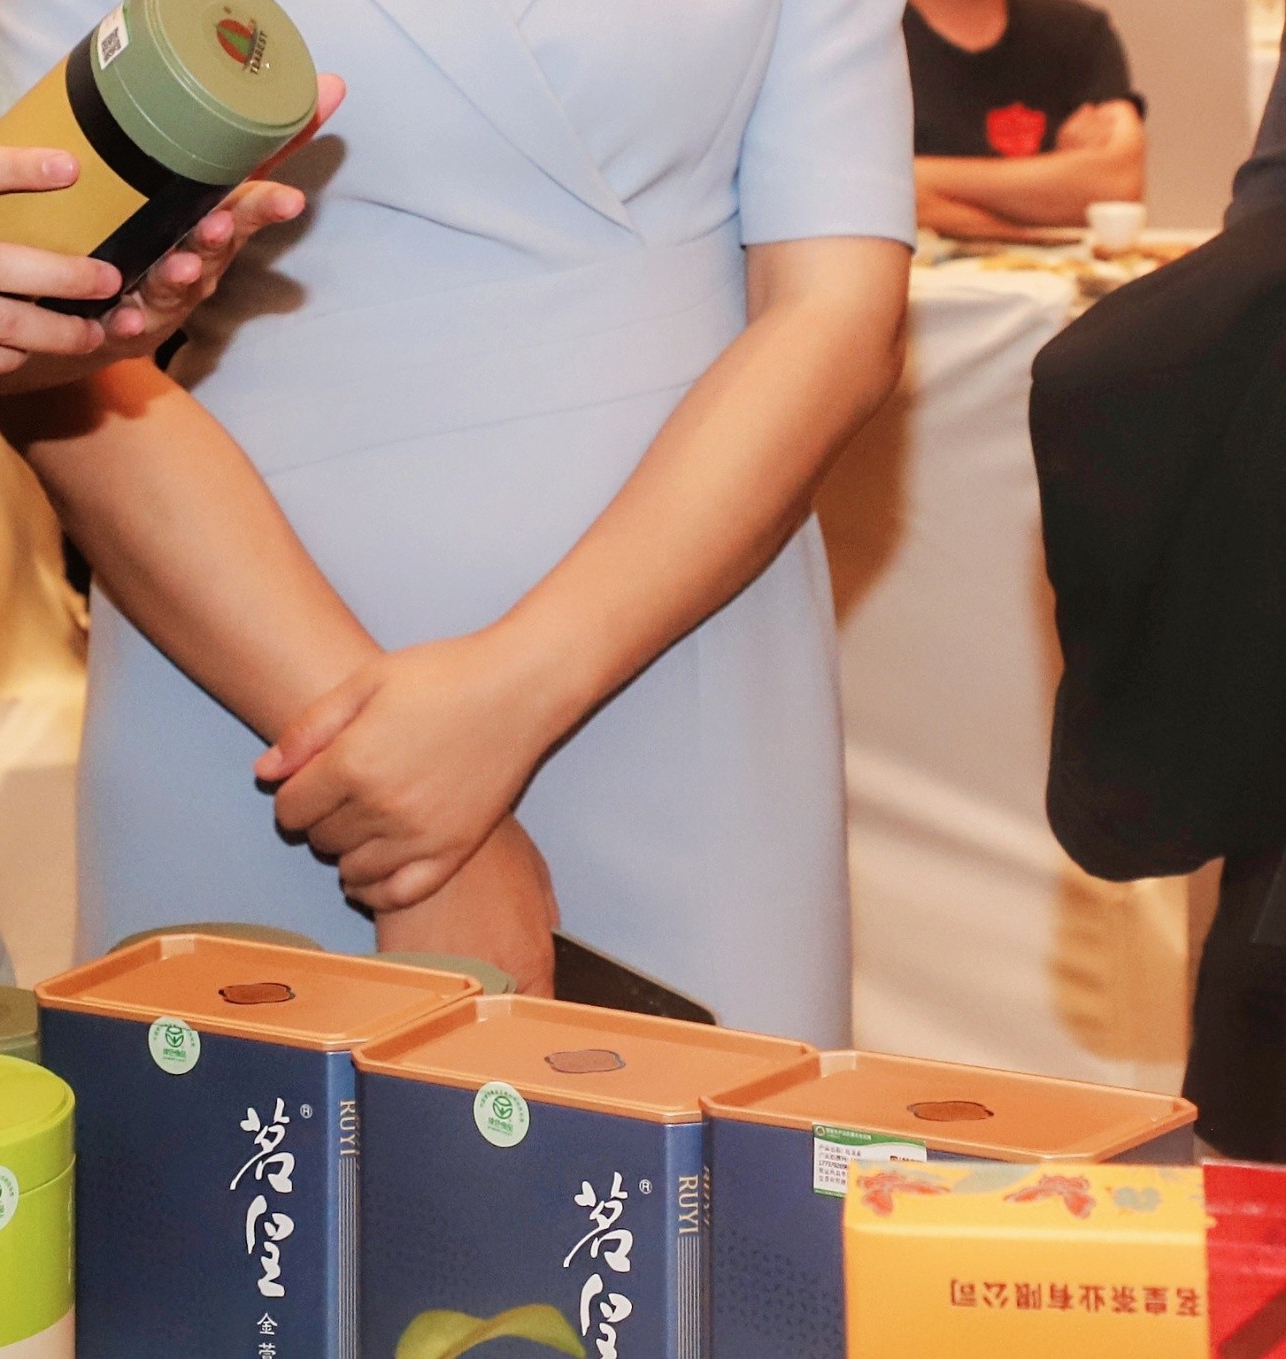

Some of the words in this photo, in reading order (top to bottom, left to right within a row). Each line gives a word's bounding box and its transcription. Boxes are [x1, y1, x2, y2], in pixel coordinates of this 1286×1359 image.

[339, 1100, 358, 1156] RUYI
[677, 1174, 699, 1235] RUYI
[949, 1278, 1202, 1319] 茗皇茶业有限公司
